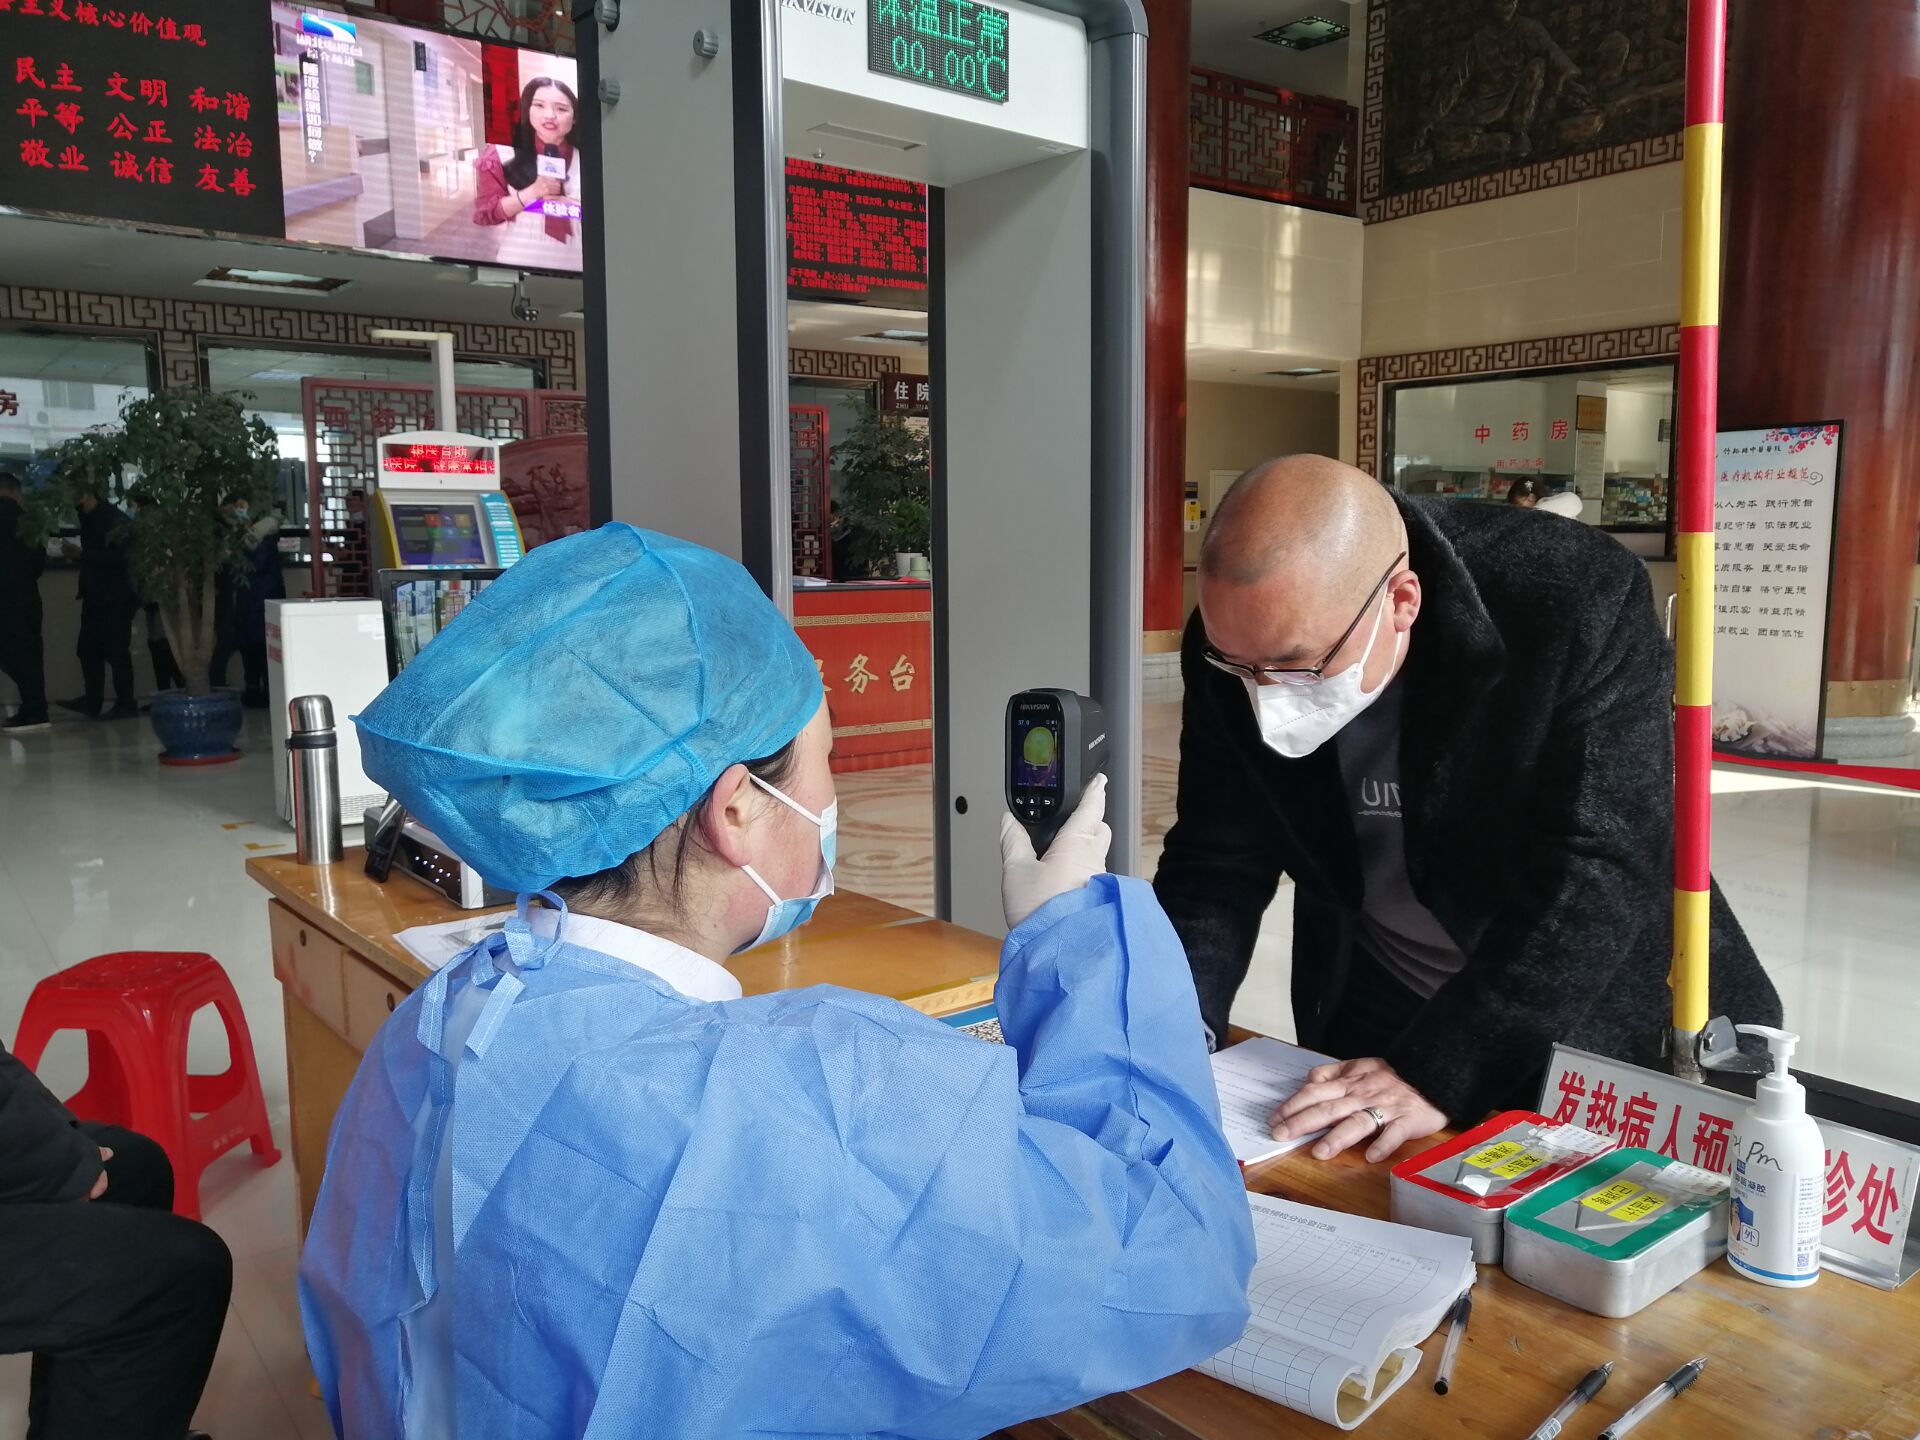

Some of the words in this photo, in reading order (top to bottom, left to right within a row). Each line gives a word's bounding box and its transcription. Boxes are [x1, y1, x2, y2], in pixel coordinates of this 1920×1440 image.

[16, 56, 83, 92] 民主
[105, 72, 168, 108] 文明
[189, 87, 251, 122] 和谐
[16, 98, 84, 135] 平等
[106, 112, 173, 143] 公正
[193, 125, 253, 157] 法治
[20, 139, 90, 171] 敬业
[110, 151, 174, 184] 诚信
[195, 163, 256, 197] 友善
[1474, 419, 1569, 444] 中药房
[1744, 1231, 1756, 1243] 外
